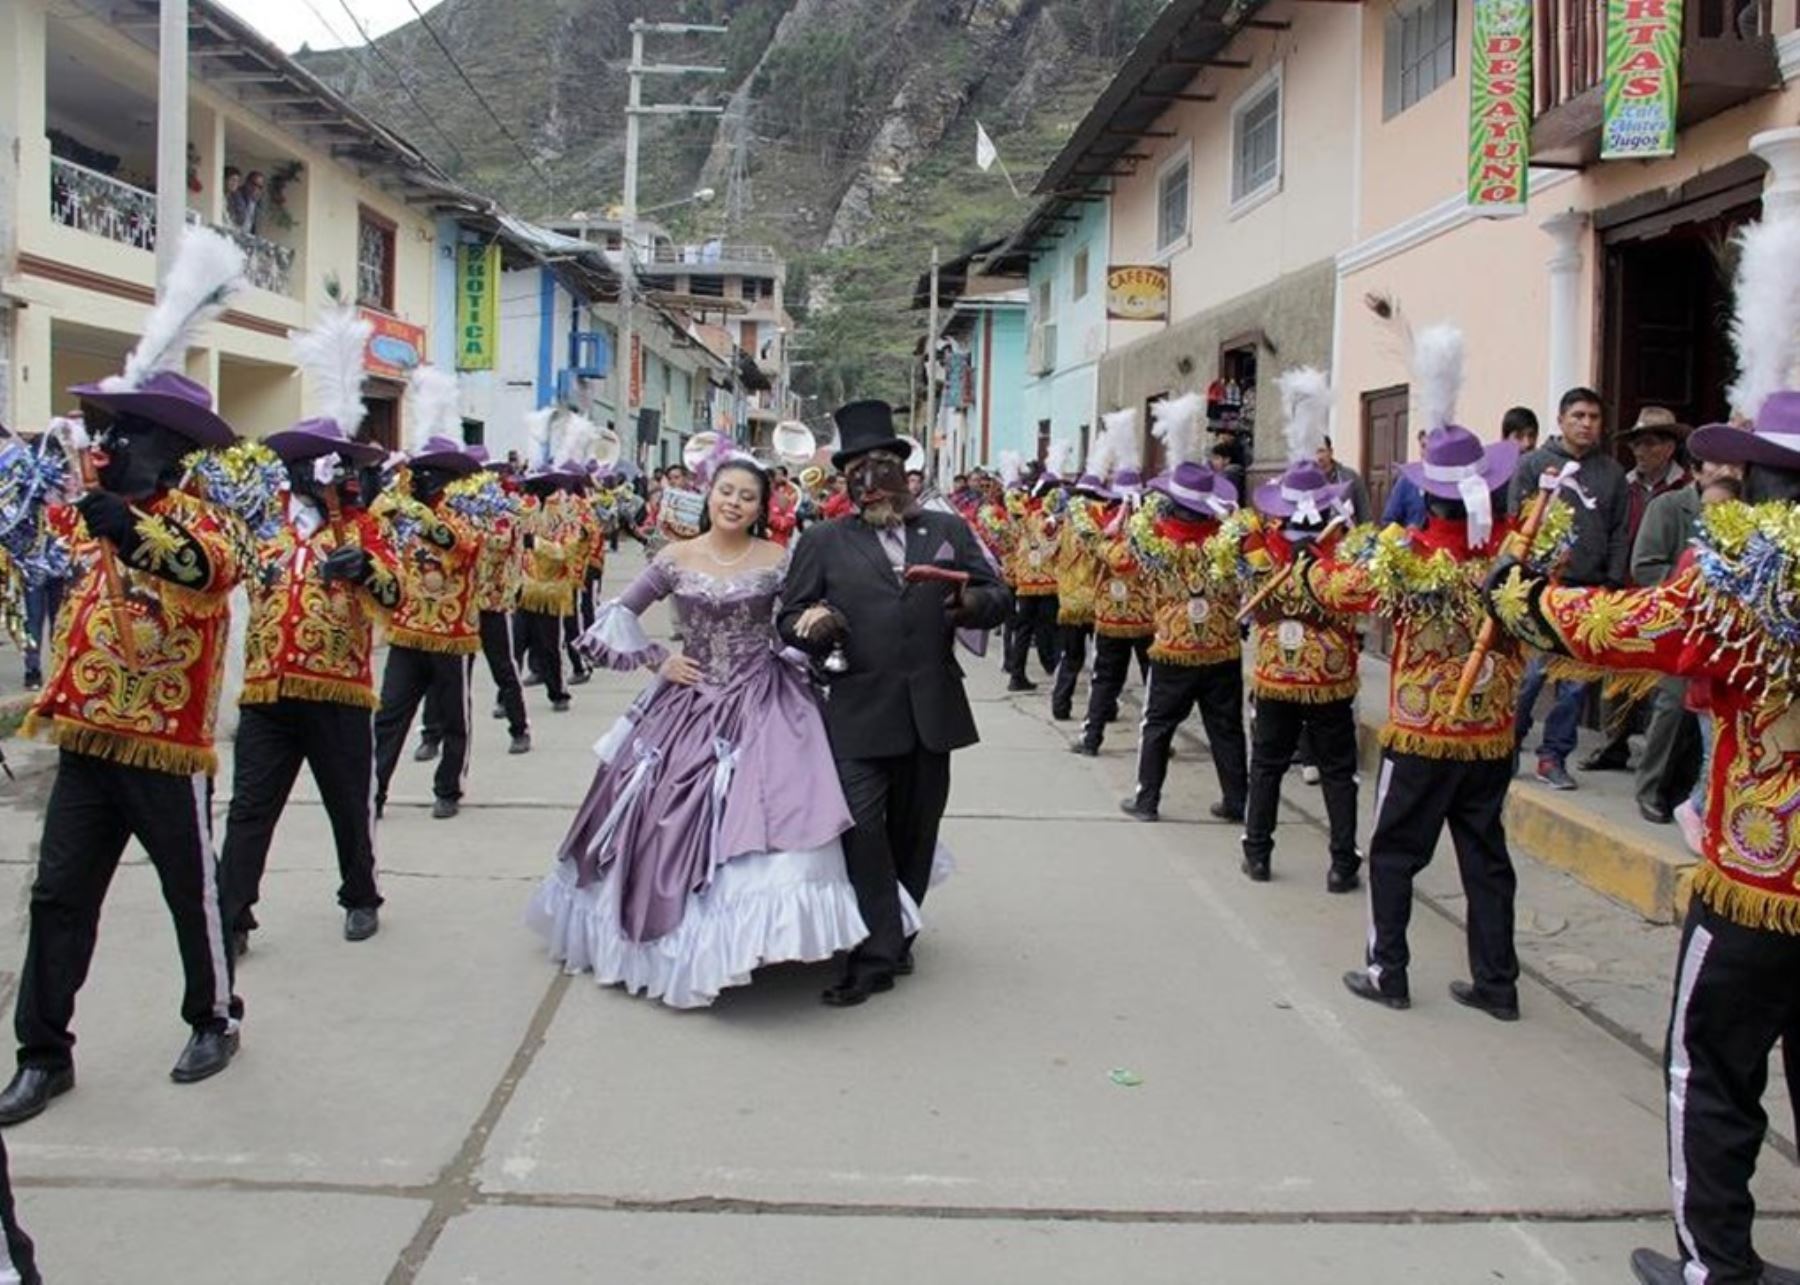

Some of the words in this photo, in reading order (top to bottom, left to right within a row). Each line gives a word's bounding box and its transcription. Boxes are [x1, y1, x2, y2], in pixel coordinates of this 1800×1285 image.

[1481, 38, 1521, 201] DESAYUNO
[1610, 133, 1660, 150] Jugos
[1108, 269, 1166, 291] CAFETIN
